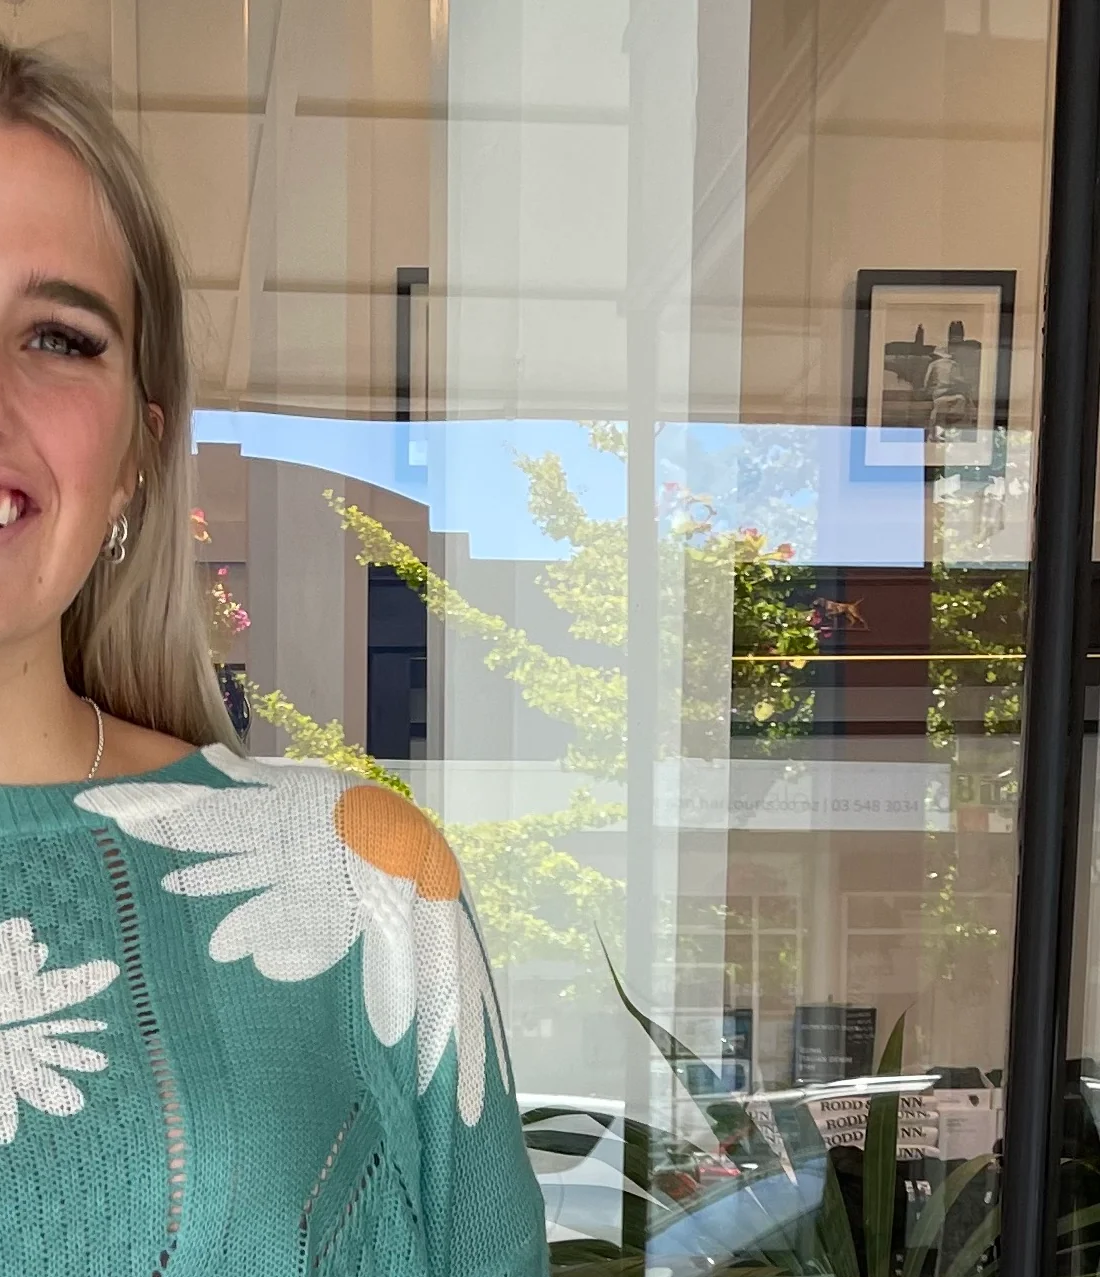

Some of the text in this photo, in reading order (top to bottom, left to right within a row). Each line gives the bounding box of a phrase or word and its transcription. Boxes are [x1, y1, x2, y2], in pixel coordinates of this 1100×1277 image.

[853, 799, 881, 812] 548
[884, 799, 919, 812] 3034
[820, 1100, 860, 1113] RODD
